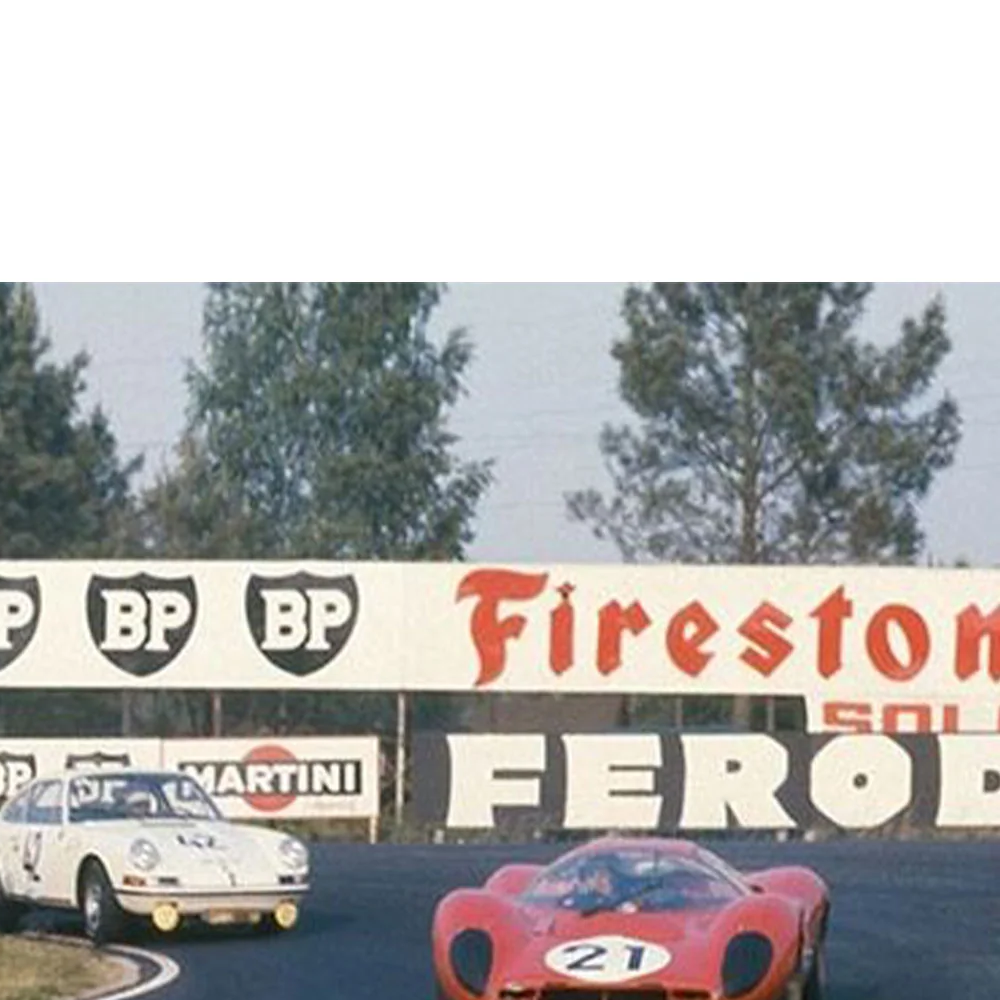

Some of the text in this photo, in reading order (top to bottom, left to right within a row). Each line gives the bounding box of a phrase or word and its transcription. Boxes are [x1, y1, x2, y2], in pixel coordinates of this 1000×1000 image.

[101, 589, 192, 652] BP
[260, 588, 352, 652] BP
[183, 763, 356, 795] MARTINI
[446, 733, 1000, 829] FEROD
[563, 943, 646, 972] 21
